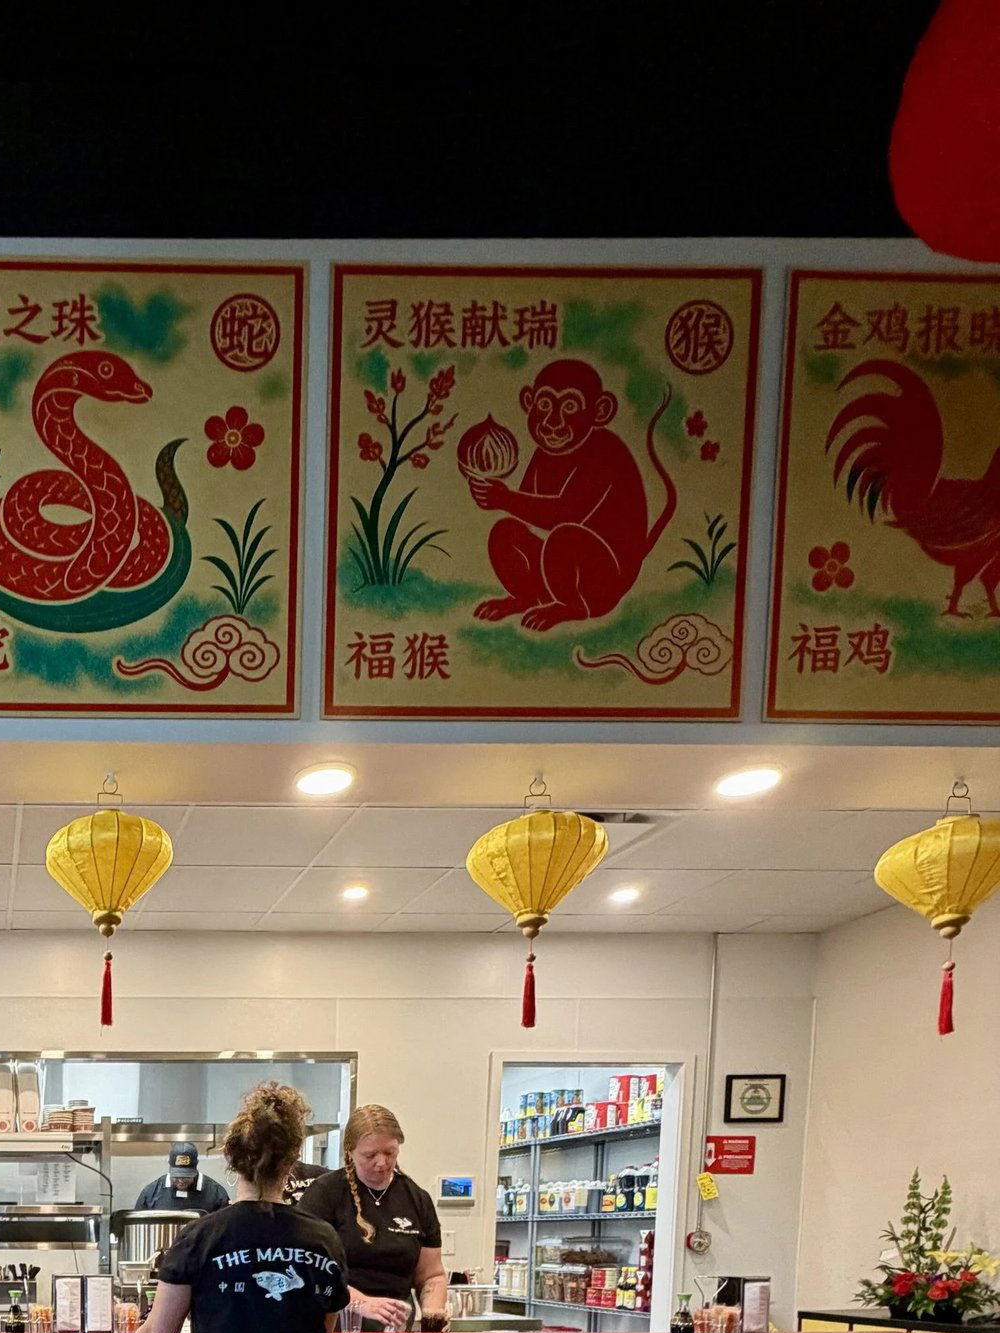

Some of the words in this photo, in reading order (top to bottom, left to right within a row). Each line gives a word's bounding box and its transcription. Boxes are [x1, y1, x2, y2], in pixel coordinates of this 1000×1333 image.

[217, 300, 274, 361] 蛇
[359, 299, 559, 350] 灵猴献瑞
[670, 306, 727, 364] 猴
[343, 631, 452, 680] 福猴
[787, 622, 893, 674] 福鸡
[212, 1248, 252, 1270] THE
[256, 1247, 338, 1275] MAJESTIC
